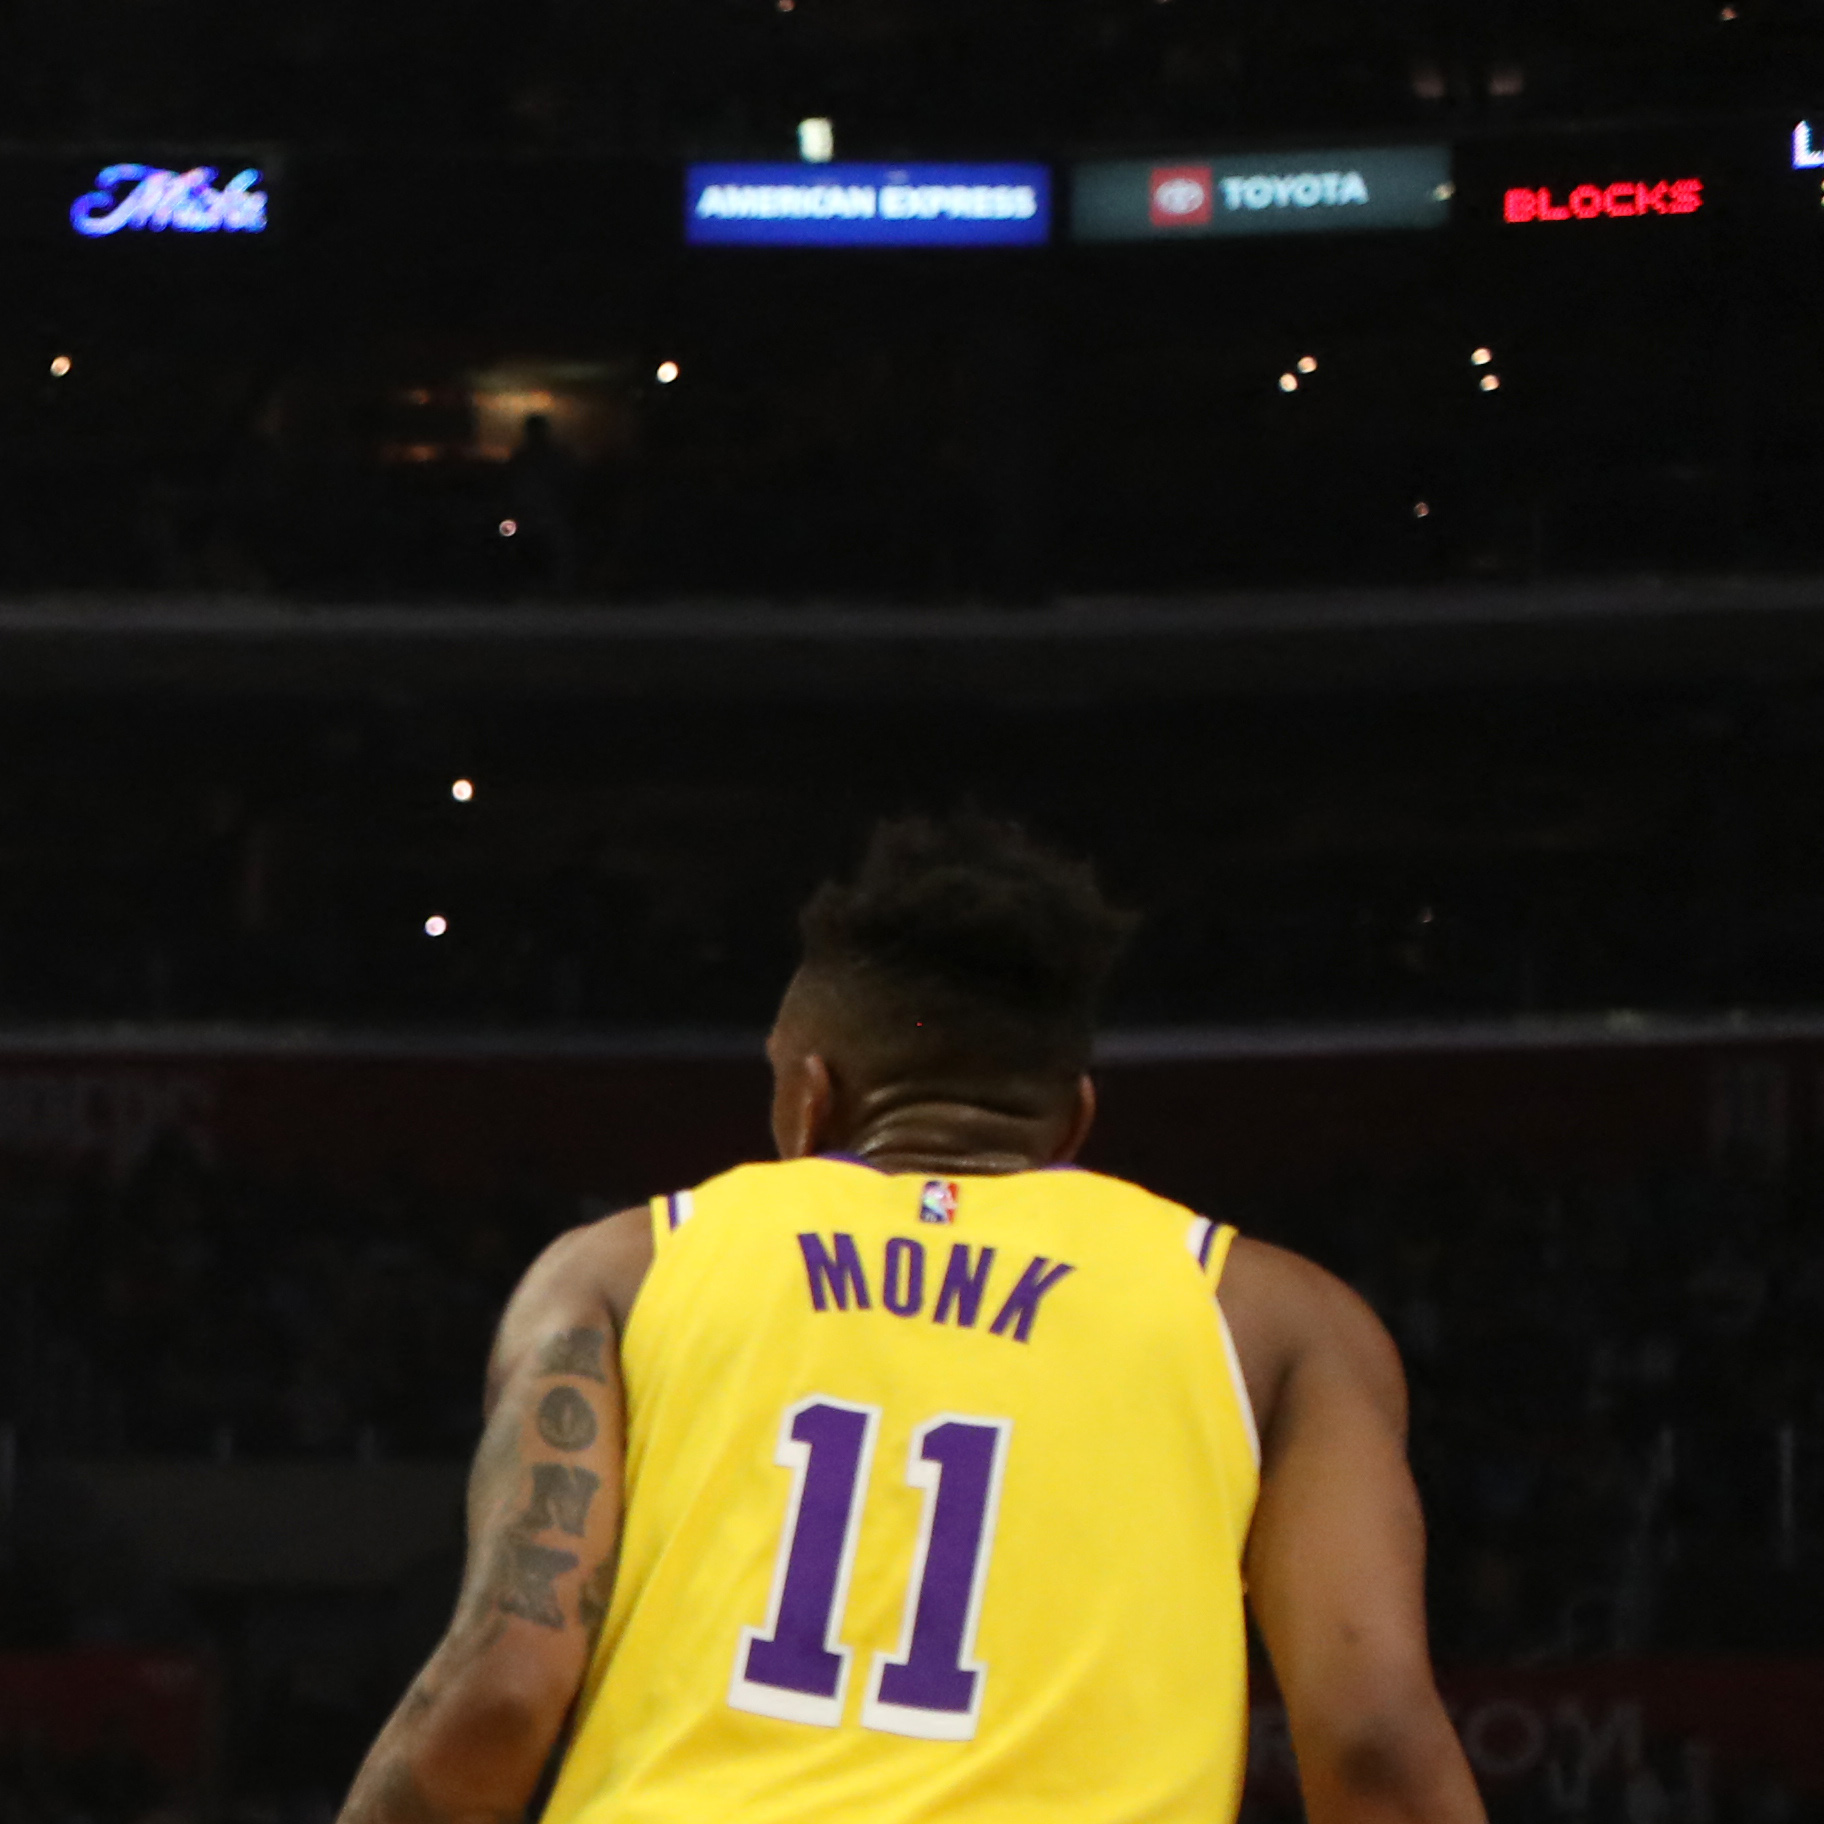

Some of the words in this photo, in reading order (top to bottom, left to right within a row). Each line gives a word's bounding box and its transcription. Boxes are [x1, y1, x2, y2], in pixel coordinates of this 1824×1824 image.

[696, 184, 876, 220] AMERICAN
[878, 184, 1038, 220] EXPRESS
[1219, 171, 1369, 210] TOYOTA
[1503, 177, 1703, 223] BLOCKS
[796, 1231, 1076, 1345] MONK
[727, 1392, 1013, 1742] 11
